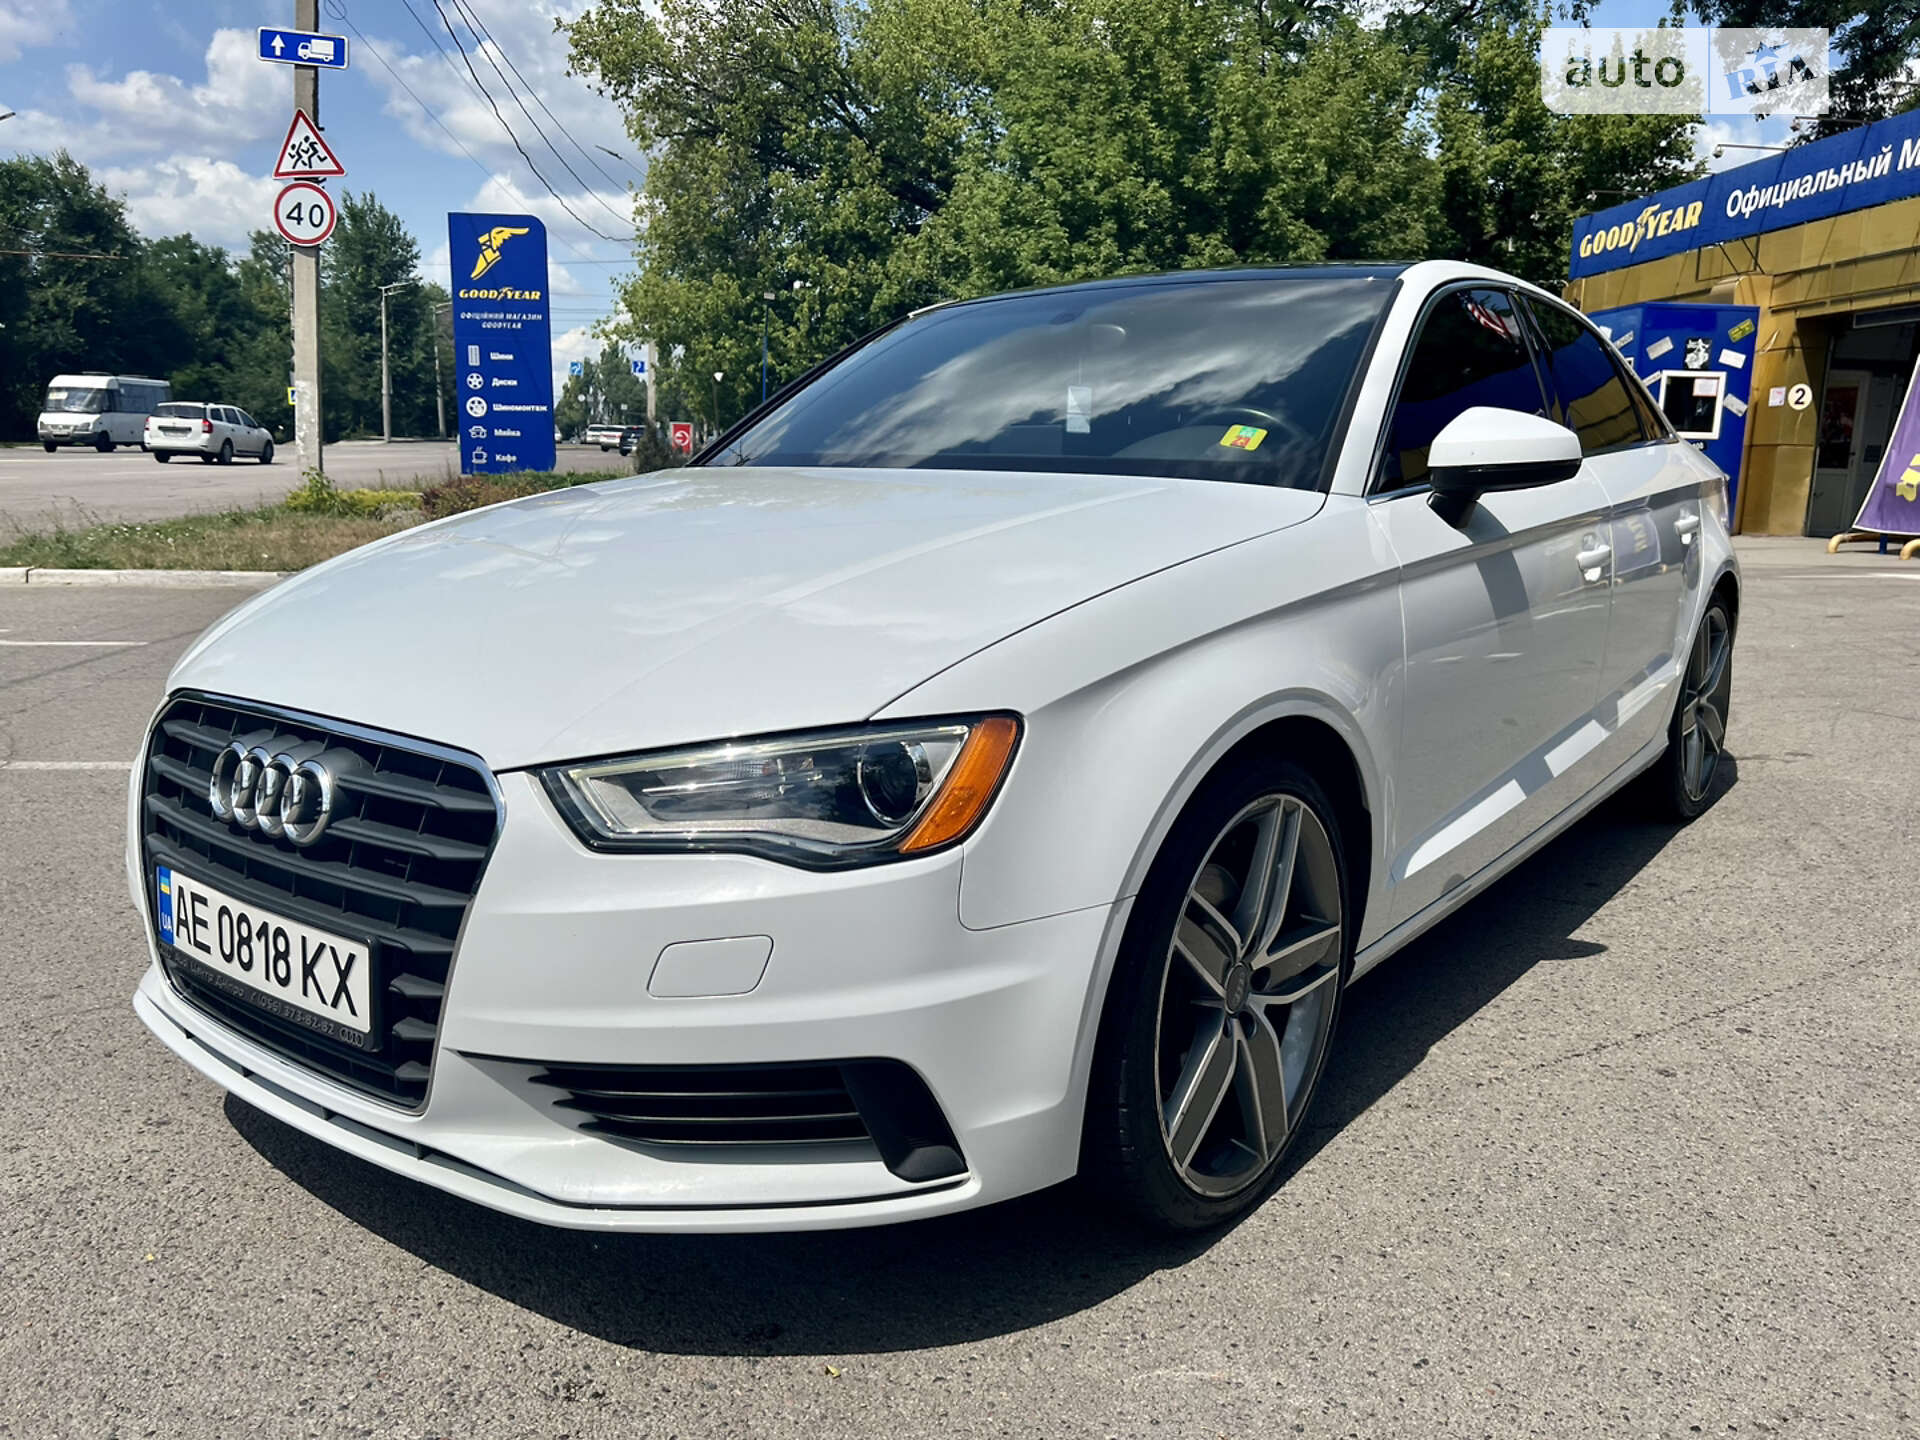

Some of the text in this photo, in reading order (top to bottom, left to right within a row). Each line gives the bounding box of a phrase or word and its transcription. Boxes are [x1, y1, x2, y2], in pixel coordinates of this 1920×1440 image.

[1726, 144, 1893, 219] Официальный
[286, 202, 324, 228] 40
[1579, 201, 1704, 258] GOODYEAR
[459, 286, 541, 300] GOODYEAR
[505, 312, 542, 321] МАГАЗИН
[482, 321, 522, 329] GOODYEAR
[492, 377, 518, 387] Диски
[1795, 388, 1805, 404] 2
[492, 403, 548, 412] Шиномонтаж
[495, 454, 518, 463] Кафе
[161, 911, 173, 932] UA
[176, 885, 359, 1017] AE 0818 KX
